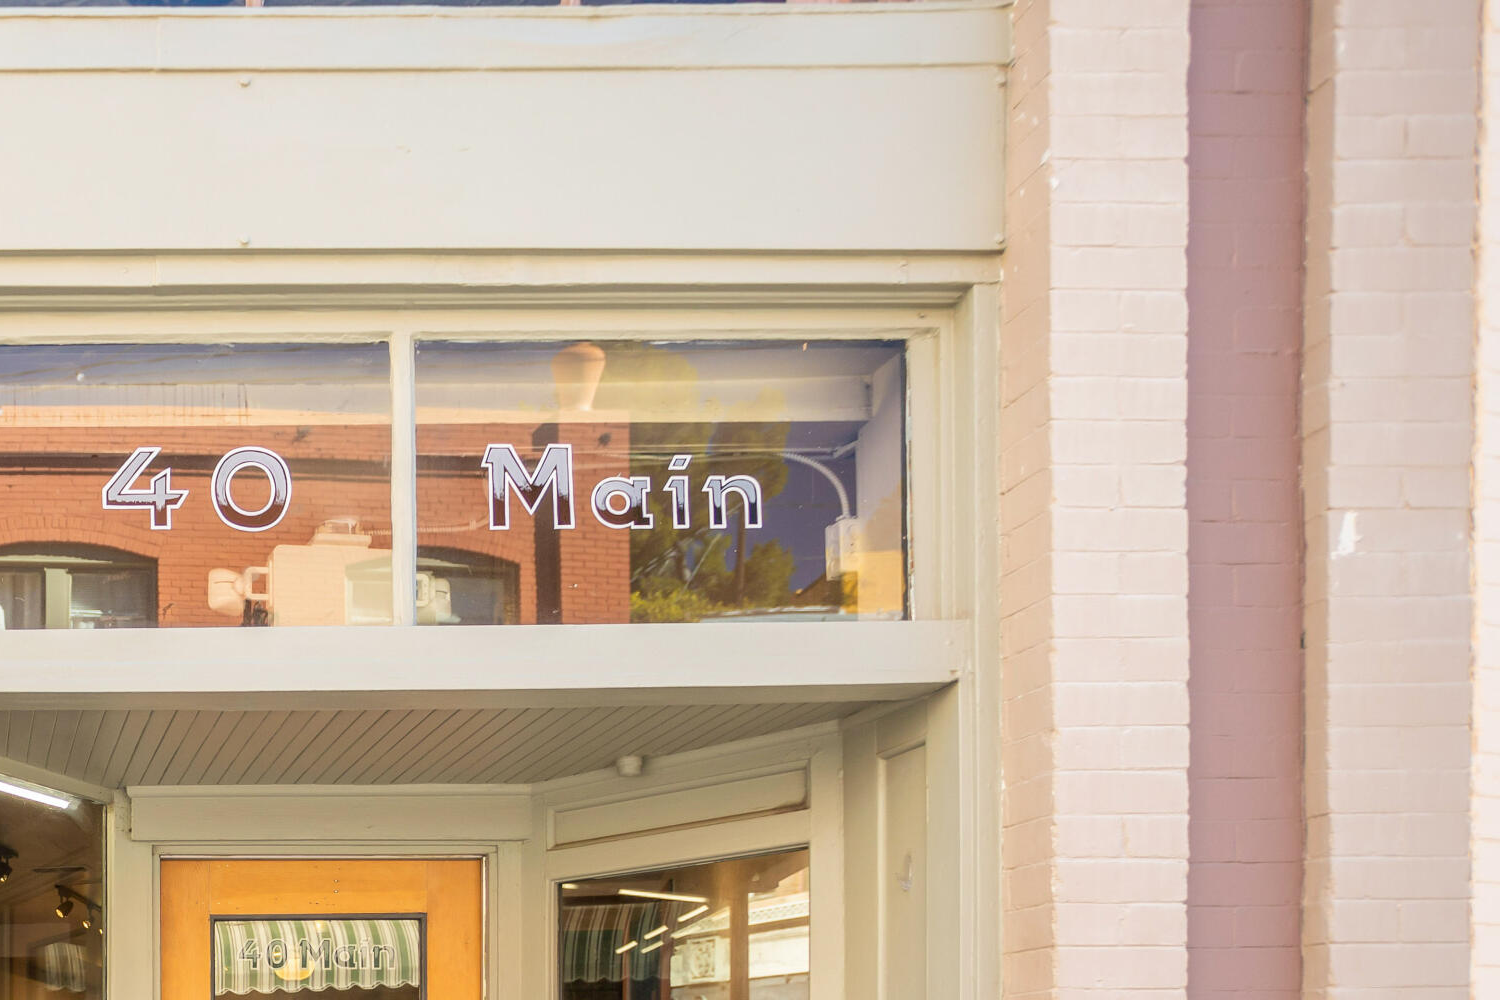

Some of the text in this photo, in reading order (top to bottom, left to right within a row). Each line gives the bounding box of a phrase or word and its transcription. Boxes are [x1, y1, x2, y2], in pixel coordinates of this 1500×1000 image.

[101, 442, 764, 532] 40 Main
[238, 937, 398, 970] 40 Main
